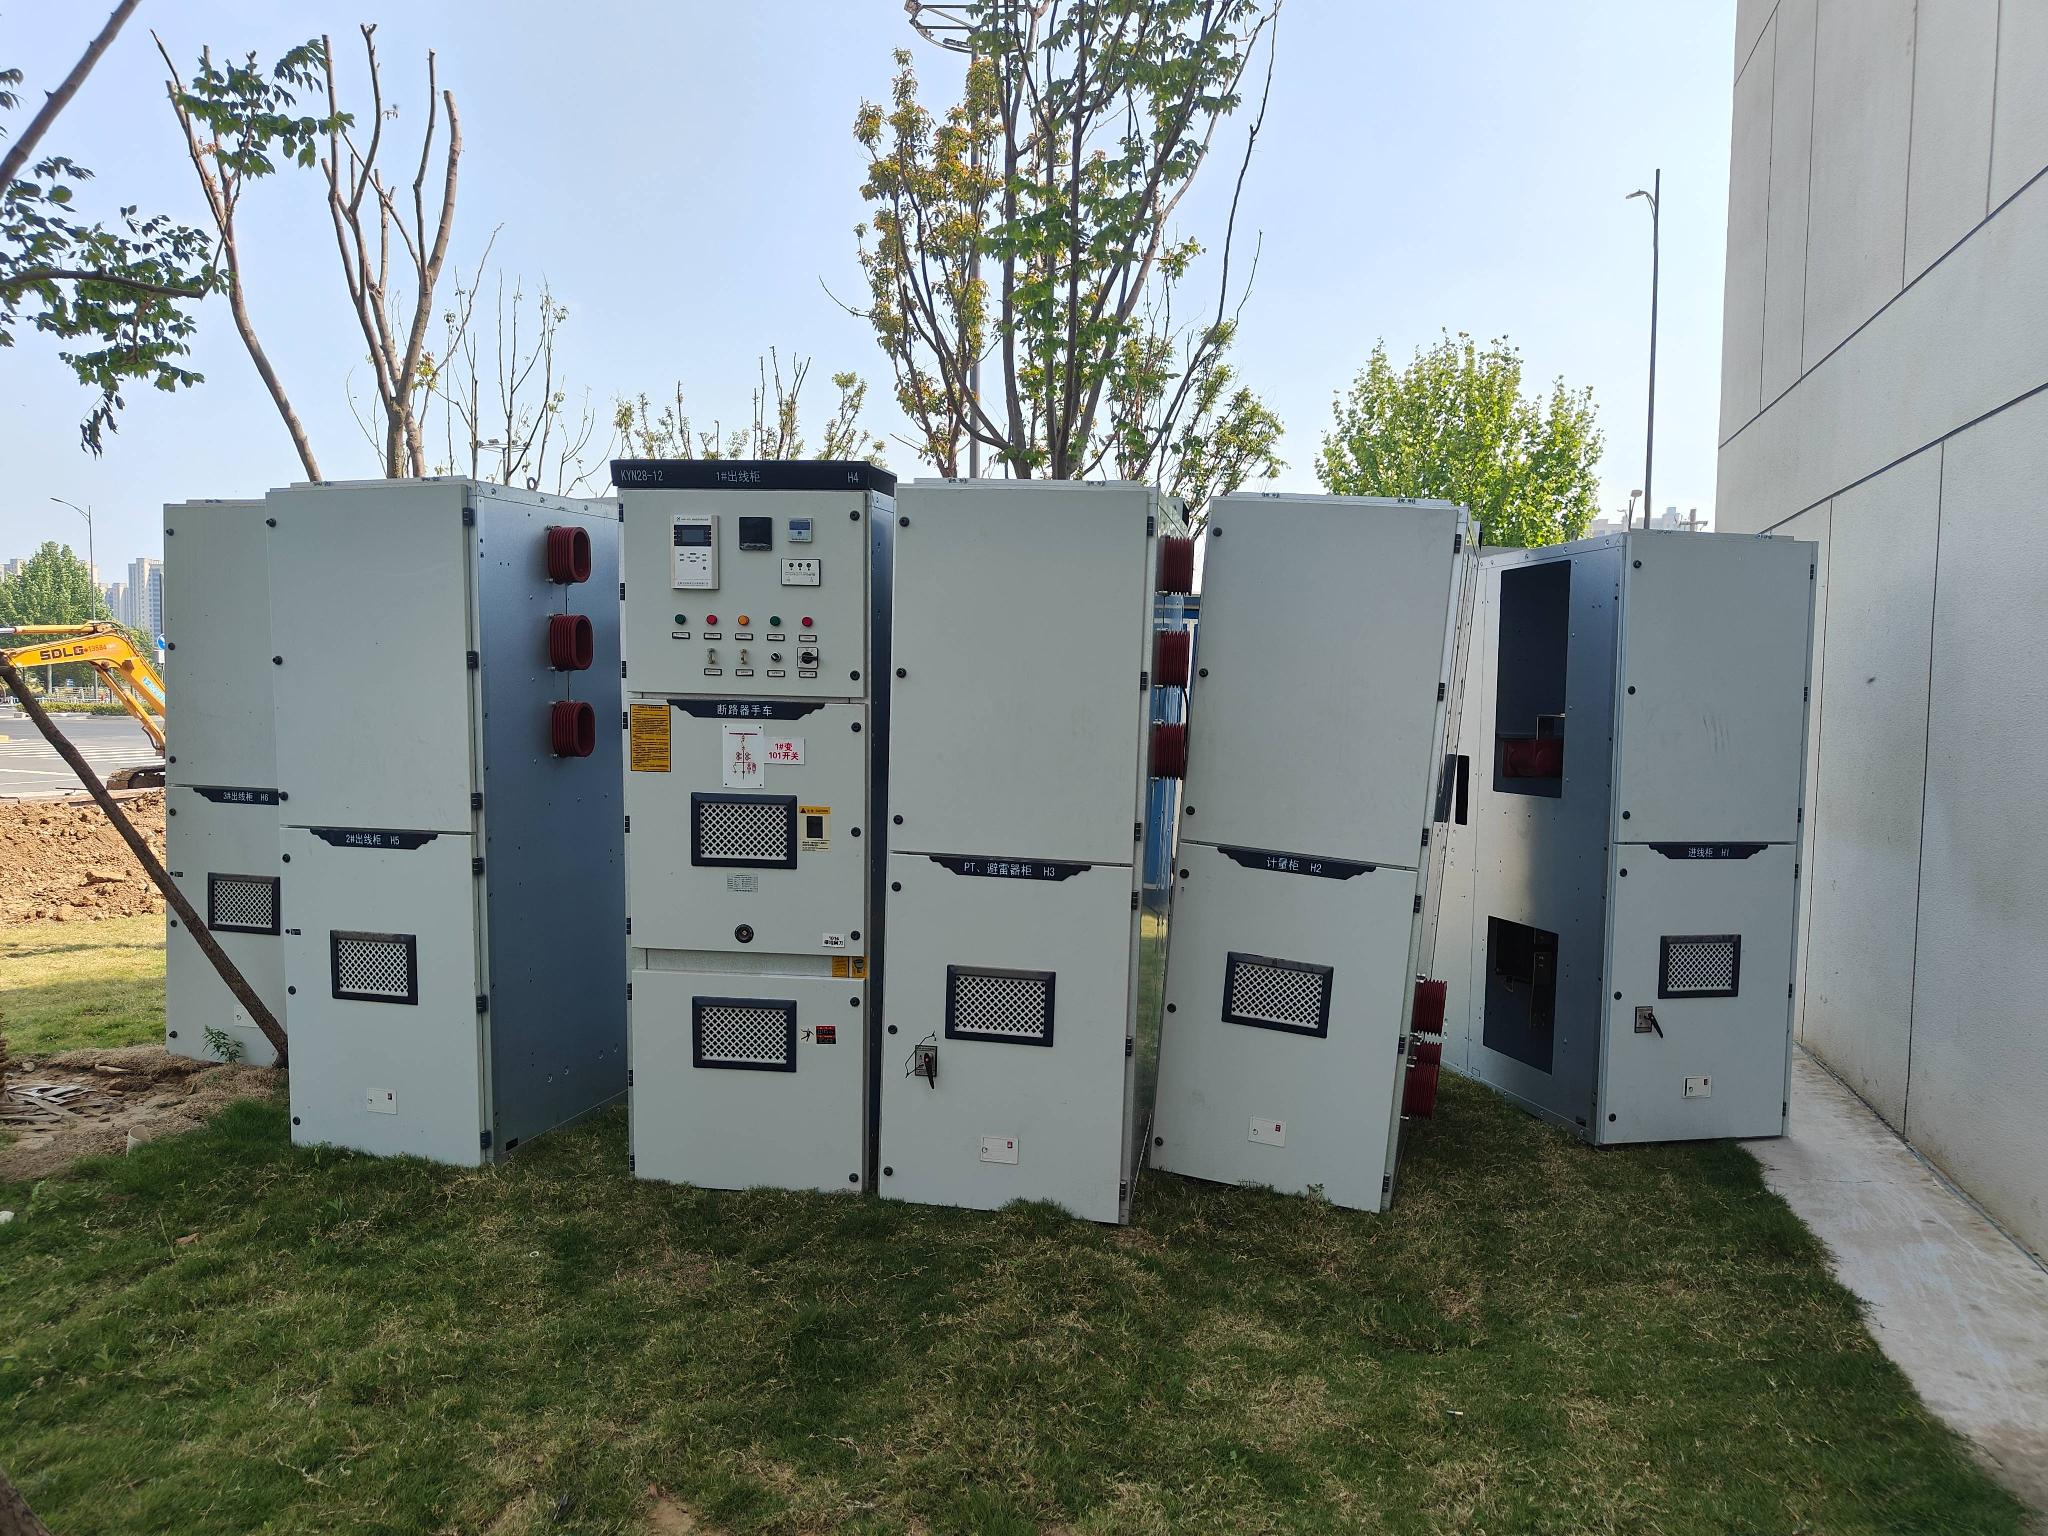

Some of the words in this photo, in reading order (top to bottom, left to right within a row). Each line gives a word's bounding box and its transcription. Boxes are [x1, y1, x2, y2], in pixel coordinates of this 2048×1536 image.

[620, 470, 664, 481] KYN28-12
[715, 471, 760, 483] 1#出线柜
[847, 472, 859, 483] H4
[40, 645, 85, 661] SDLG
[717, 704, 773, 716] 断路器手车
[774, 742, 793, 752] 1#变
[768, 751, 799, 761] 101开关
[223, 791, 254, 802] 3#出线柜
[260, 793, 269, 802] H6
[345, 834, 382, 846] 2#出线柜
[390, 835, 400, 845] H5
[1688, 847, 1713, 858] 进线柜
[1266, 857, 1300, 871] 计量柜
[1310, 862, 1322, 874] H2
[1043, 866, 1055, 877] H3
